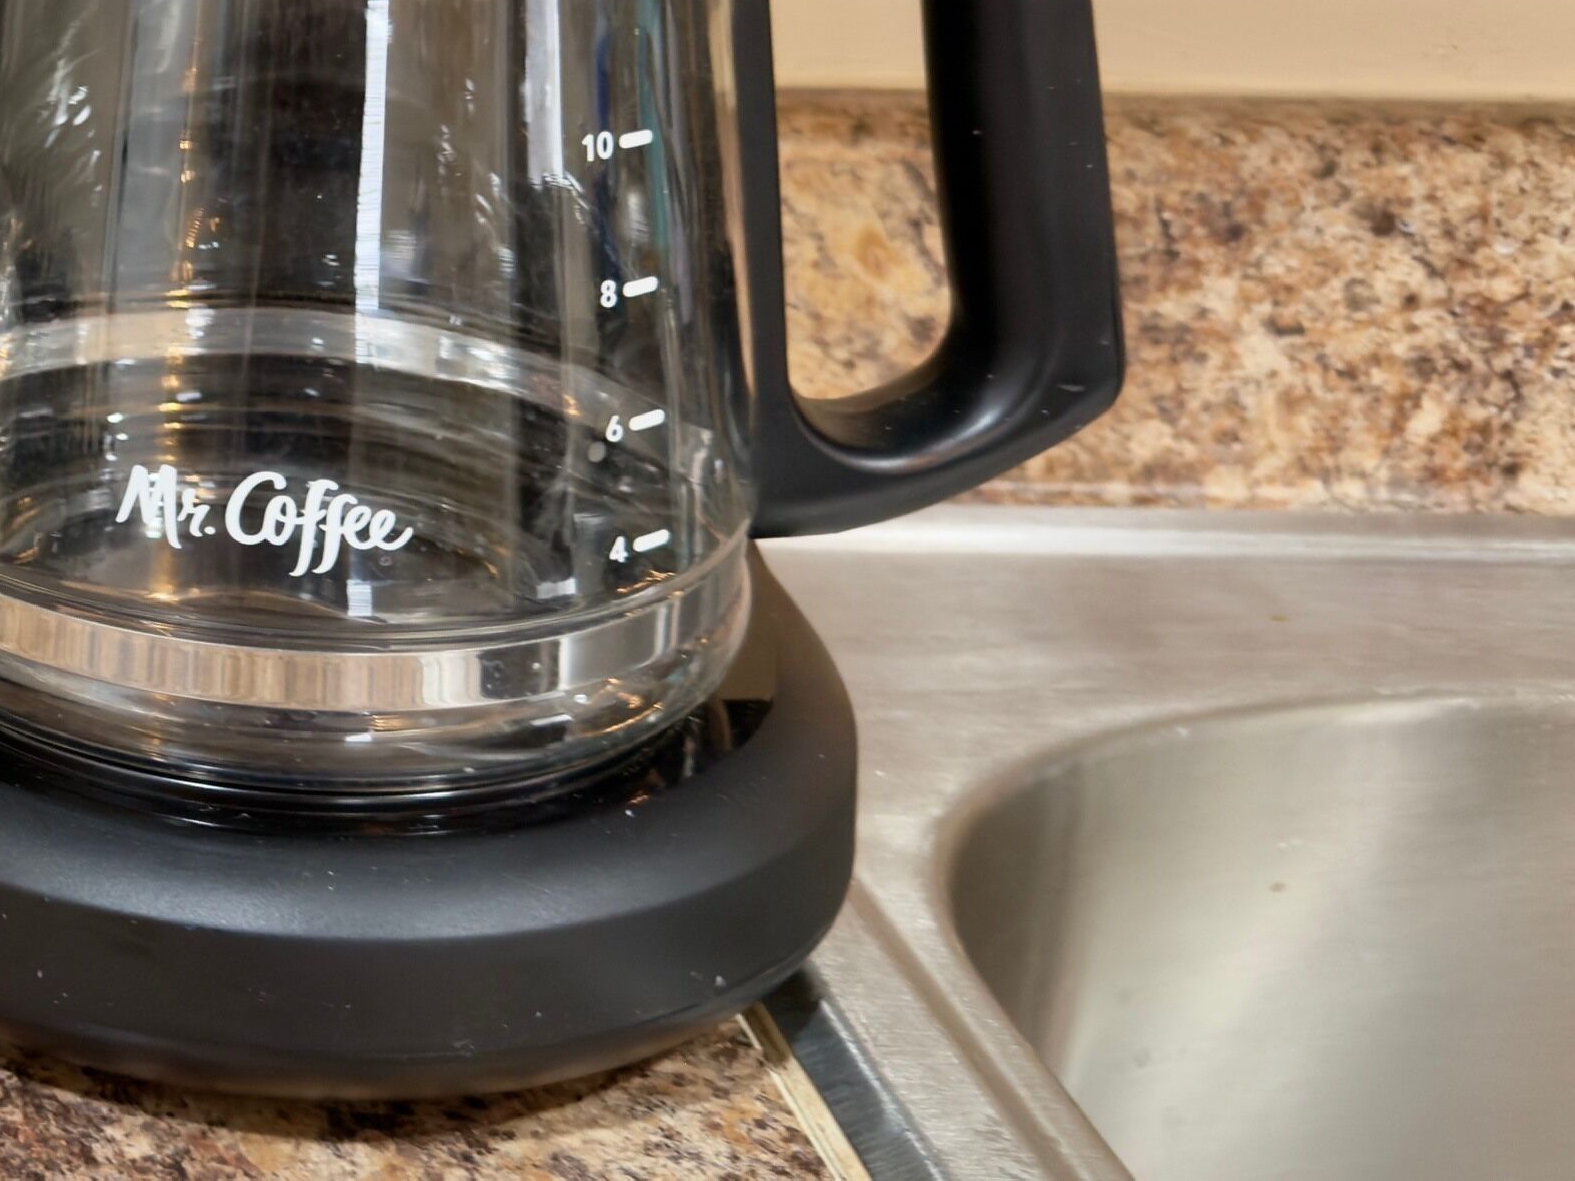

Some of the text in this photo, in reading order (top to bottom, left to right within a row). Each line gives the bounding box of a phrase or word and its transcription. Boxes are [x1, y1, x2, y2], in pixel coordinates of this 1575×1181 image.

[581, 130, 614, 163] 10
[599, 279, 618, 309] 8
[605, 414, 624, 443] 6
[115, 463, 414, 577] Mr. Coffee
[608, 534, 629, 564] 4
